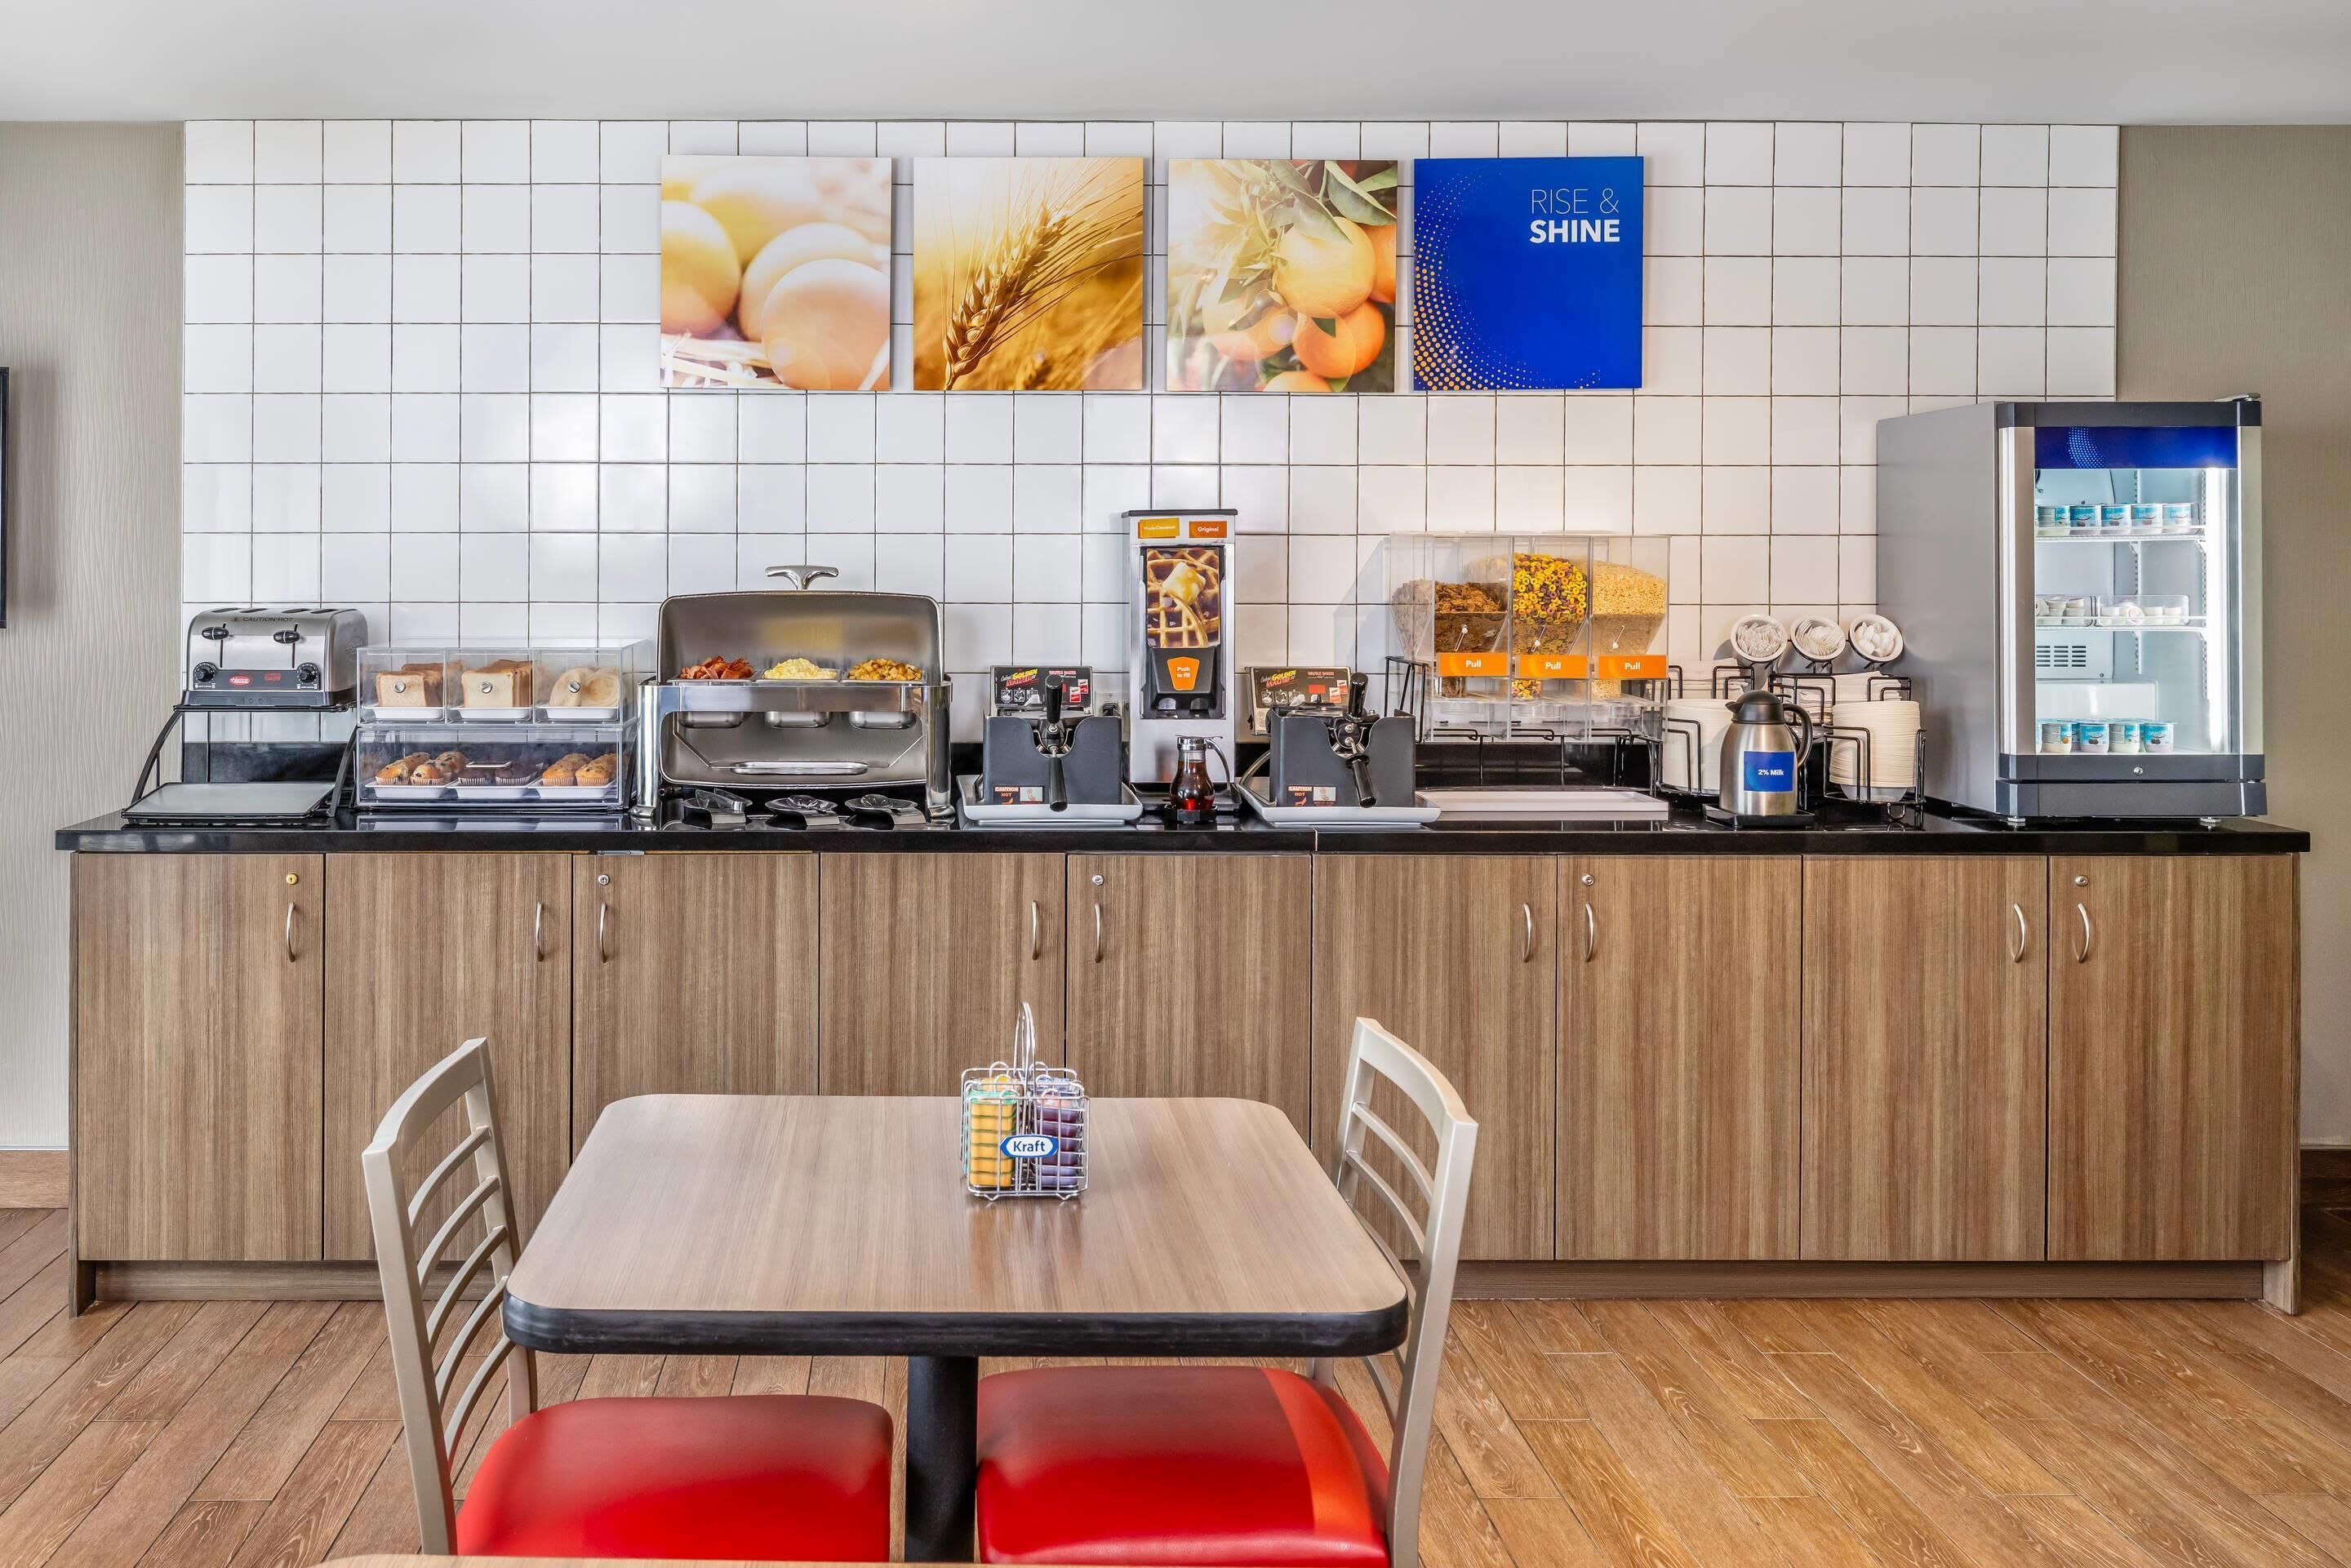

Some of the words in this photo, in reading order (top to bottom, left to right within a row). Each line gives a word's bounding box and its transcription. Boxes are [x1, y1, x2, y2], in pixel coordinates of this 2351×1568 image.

[1531, 188, 1589, 215] RISE
[1599, 188, 1620, 214] &
[1529, 219, 1620, 244] SHINE
[1465, 660, 1482, 668] Pull
[1624, 662, 1641, 670] Pull
[1012, 668, 1038, 680] GOLDEN
[1271, 669, 1296, 681] GOLDEN
[1013, 1139, 1046, 1152] Kraft
